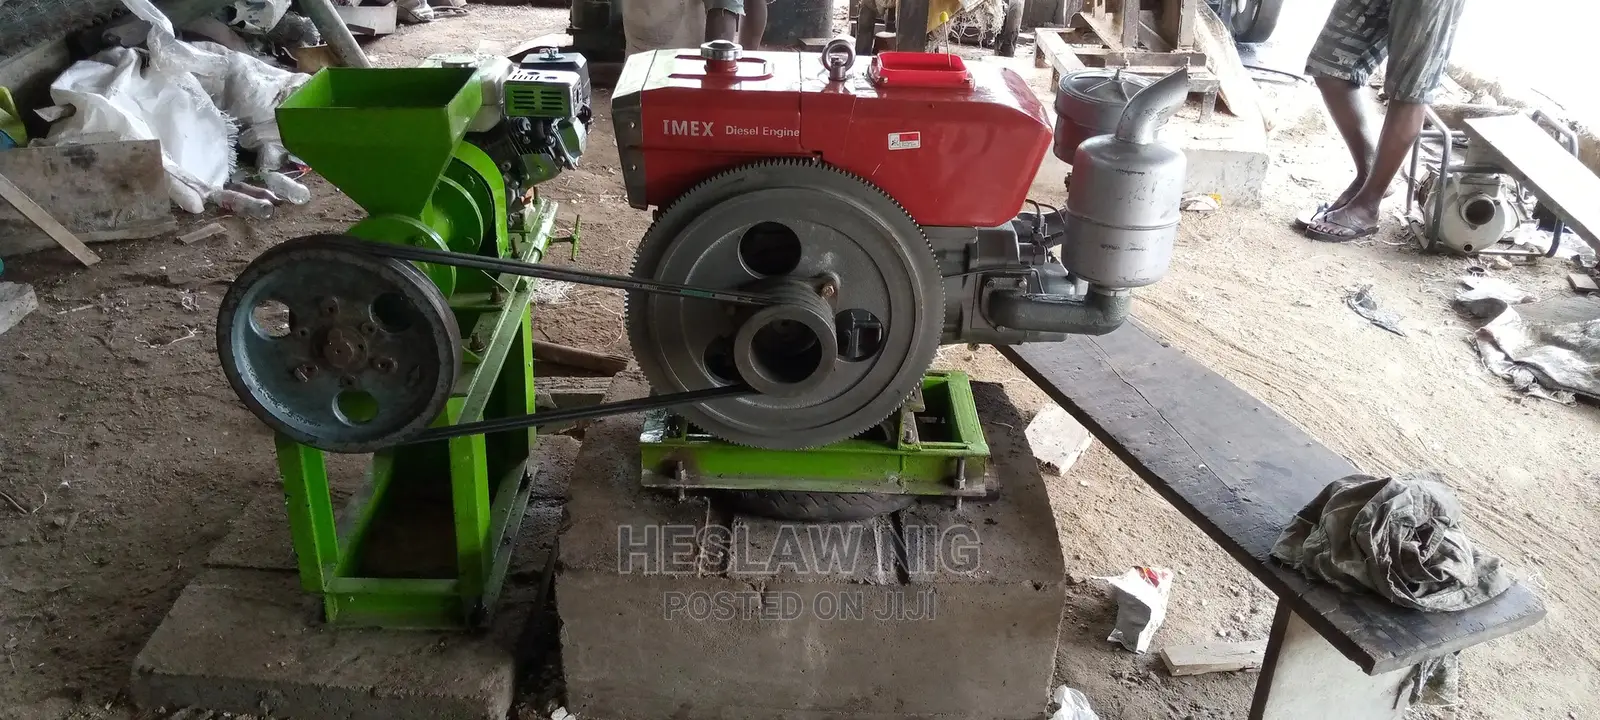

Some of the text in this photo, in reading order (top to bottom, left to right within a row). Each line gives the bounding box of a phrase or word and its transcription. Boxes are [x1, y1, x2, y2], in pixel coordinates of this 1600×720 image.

[663, 119, 800, 138] IMEX Diesel Engine
